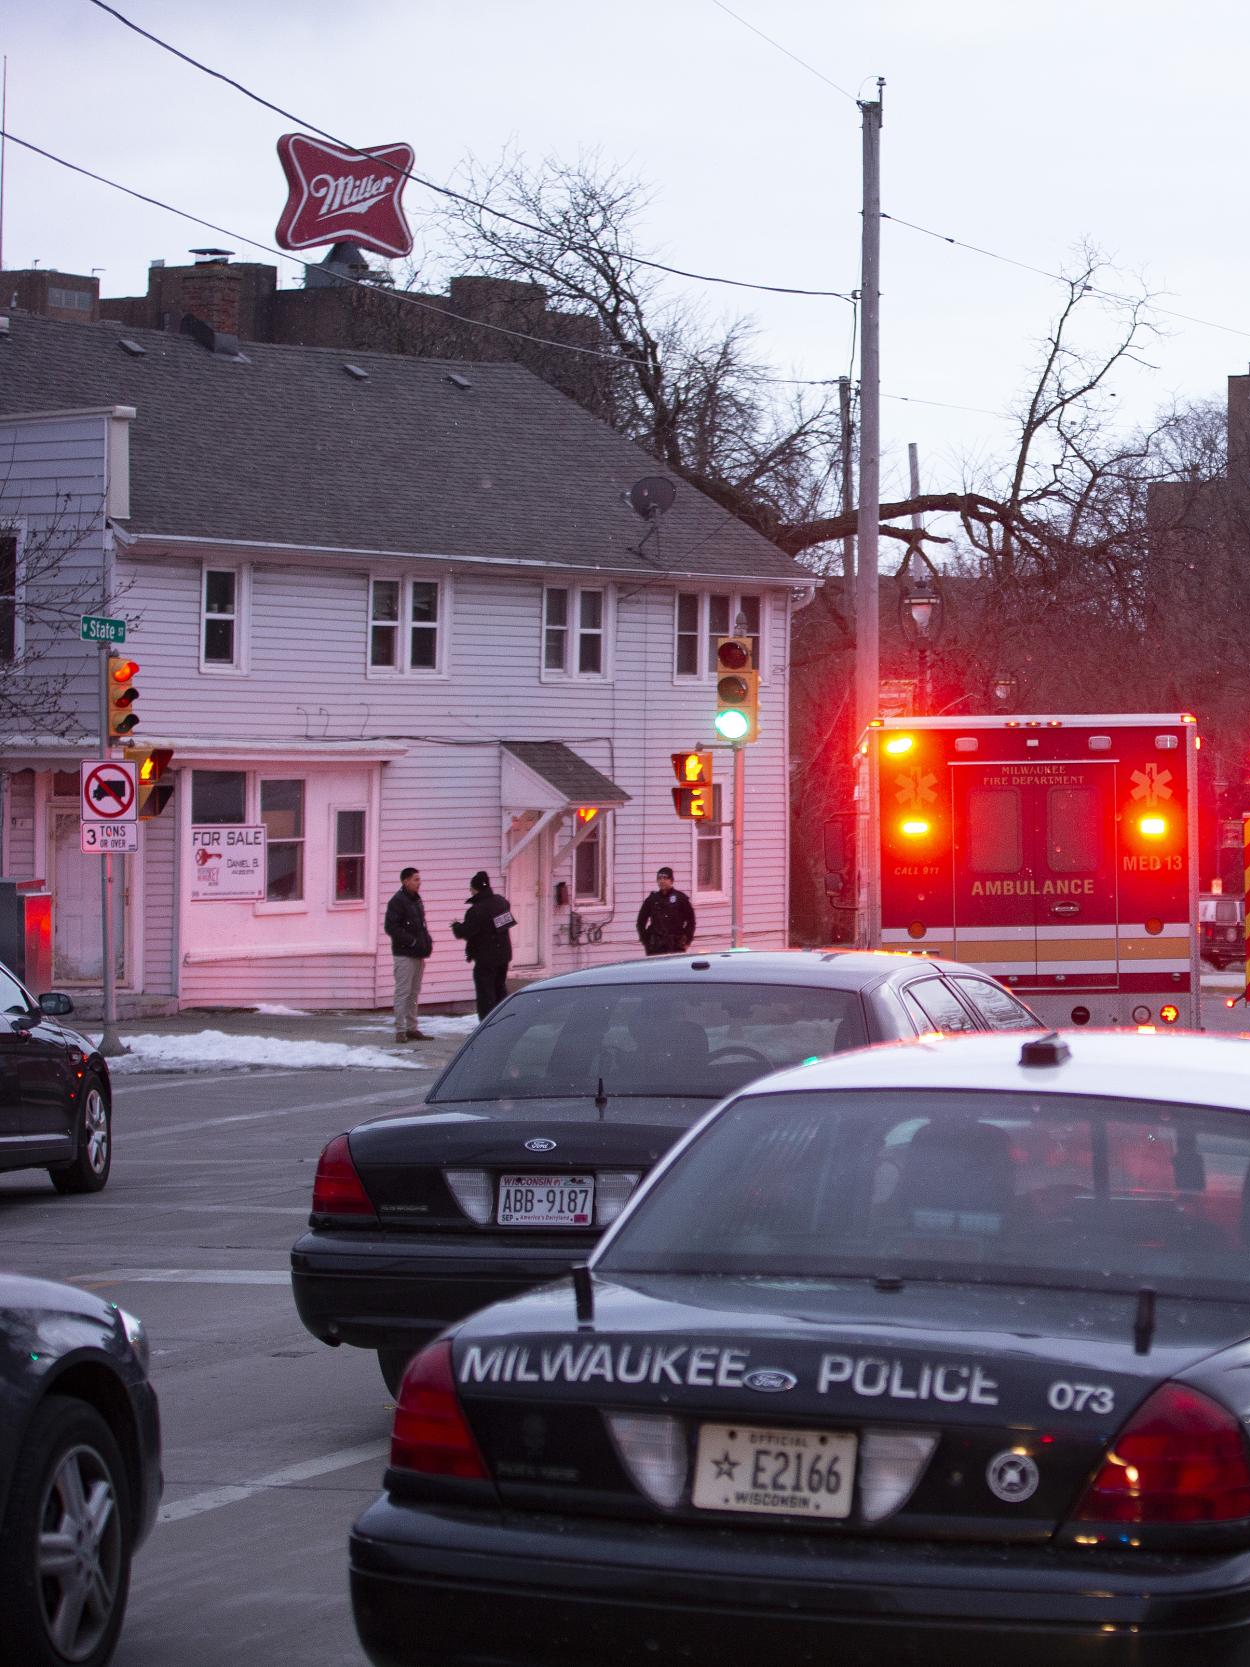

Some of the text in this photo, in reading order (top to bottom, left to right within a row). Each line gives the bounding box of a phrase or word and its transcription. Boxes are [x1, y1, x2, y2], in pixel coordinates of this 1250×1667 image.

[310, 174, 394, 215] Miller
[90, 621, 115, 639] State
[1001, 765, 1066, 775] MILWAUKEE
[983, 775, 1084, 786] FIRE DEPARTMENT
[86, 829, 97, 845] 3
[100, 826, 126, 837] TONS
[193, 831, 262, 847] FOR SALE
[100, 840, 108, 848] OR
[111, 840, 126, 849] OVER
[894, 866, 939, 876] CALL 911
[1124, 855, 1183, 871] MED 13
[972, 879, 1094, 896] AMBULANCE
[503, 1177, 553, 1186] WISCONSIN
[503, 1189, 589, 1214] ABB-9187
[460, 1344, 749, 1387] MILWAUKEE
[817, 1354, 999, 1405] POLICE
[1048, 1381, 1115, 1414] 073
[750, 1433, 808, 1447] OFFICIAL
[753, 1450, 841, 1495] E2166
[735, 1491, 811, 1509] WISCONSIN
